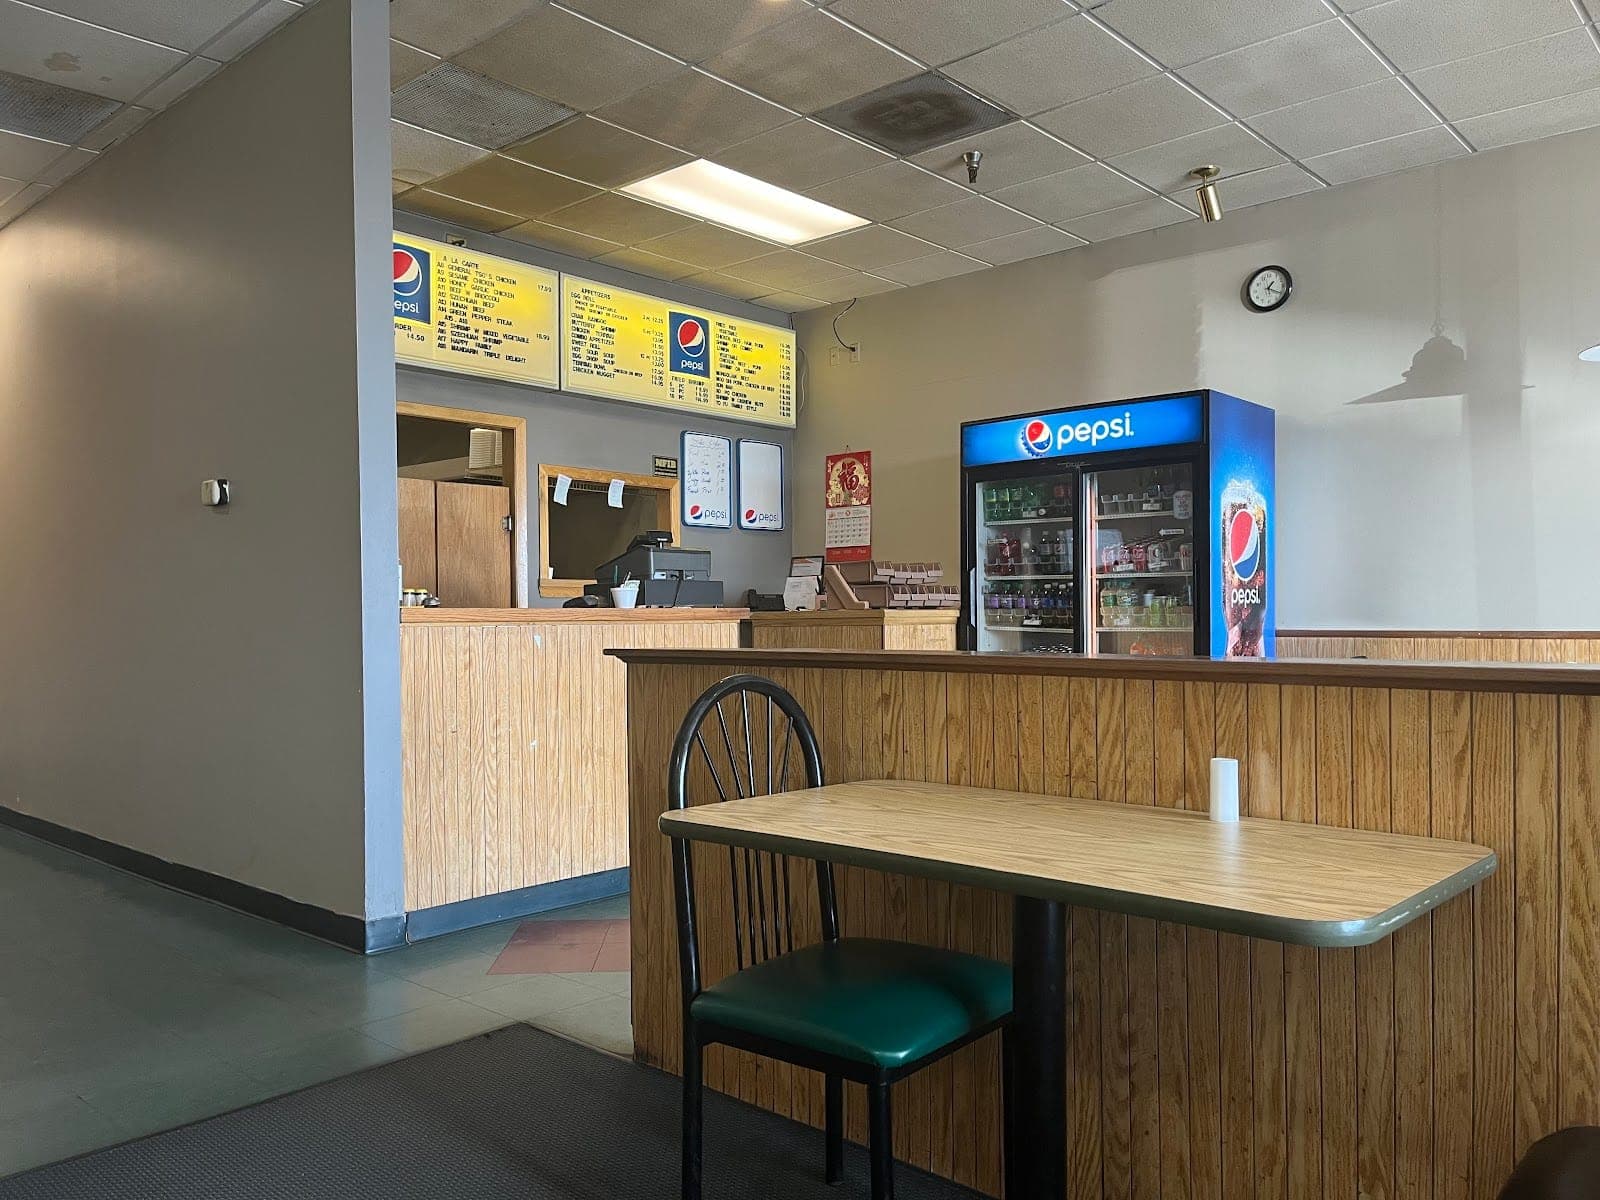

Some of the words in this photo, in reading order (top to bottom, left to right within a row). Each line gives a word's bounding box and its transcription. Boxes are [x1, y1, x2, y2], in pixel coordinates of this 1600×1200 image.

[448, 264, 470, 275] GENERAL
[496, 275, 516, 285] CHICKEN
[449, 272, 468, 281] SESAME
[473, 277, 494, 287] CHICKEN
[449, 279, 466, 288] HONEY
[471, 284, 488, 293] GARLIC
[494, 289, 514, 299] CHICKEN
[450, 286, 460, 294] BEEF
[475, 292, 499, 302] BROCCOLI
[582, 288, 610, 300] APPETIZERS
[450, 294, 477, 305] SZECHUAN
[583, 294, 595, 302] ROLL
[394, 300, 418, 313] epsi
[450, 301, 468, 310] HUNAN
[473, 306, 485, 314] BEEF
[450, 308, 466, 317] GREEN
[472, 313, 491, 322] PEPPER
[497, 318, 512, 327] STEAK
[395, 323, 411, 331] RDER
[450, 323, 470, 332] SHRIMP
[503, 333, 529, 343] VEGETABLE
[572, 326, 589, 334] CHICKEN
[601, 325, 616, 333] SHRIMP
[451, 330, 478, 341] SZECHUAN
[483, 336, 502, 345] SHRIMP
[451, 337, 468, 346] HAPPY
[476, 342, 491, 350] FAMILY
[572, 339, 586, 347] SWEET
[590, 336, 614, 346] APPETIZER
[451, 345, 478, 355] MANDARIN
[484, 351, 500, 359] TRIPLE
[505, 355, 526, 363] DELIGHT
[681, 359, 704, 371] pepsi
[573, 366, 593, 375] CHICKEN
[597, 370, 615, 379] NUGGET
[705, 509, 727, 520] pepsi
[759, 512, 779, 523] pepsi
[1231, 585, 1261, 608] pepsi
